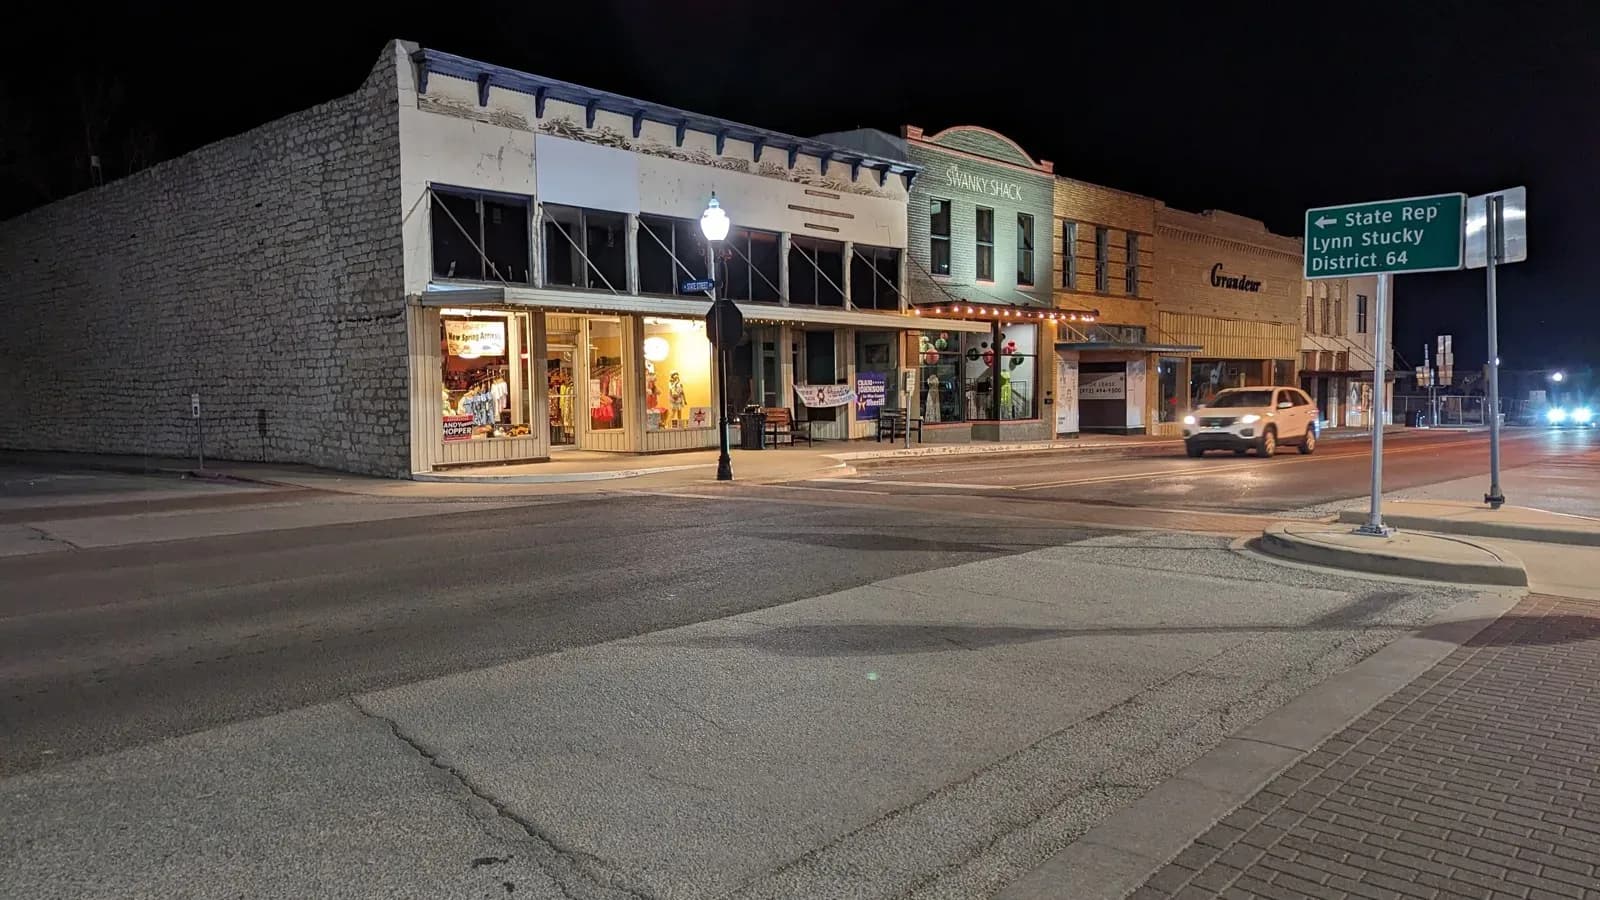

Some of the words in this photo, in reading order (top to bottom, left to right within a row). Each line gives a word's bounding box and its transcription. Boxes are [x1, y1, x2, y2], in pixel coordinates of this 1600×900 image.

[946, 168, 988, 193] SWANKY
[990, 179, 1022, 201] SHACK
[1345, 209, 1392, 227] State
[1402, 205, 1438, 222] Rep
[1313, 235, 1353, 254] Lynn
[1361, 228, 1424, 247] Stucky
[1312, 254, 1376, 271] District
[1386, 250, 1408, 266] 64
[1211, 262, 1261, 293] Grandeur
[448, 331, 460, 341] New
[462, 332, 480, 343] Spring
[481, 331, 502, 342] Arriv
[857, 385, 885, 394] JOHNSON
[866, 398, 885, 406] Sheriff
[443, 421, 462, 429] ANDY
[443, 427, 472, 436] HOPPER
